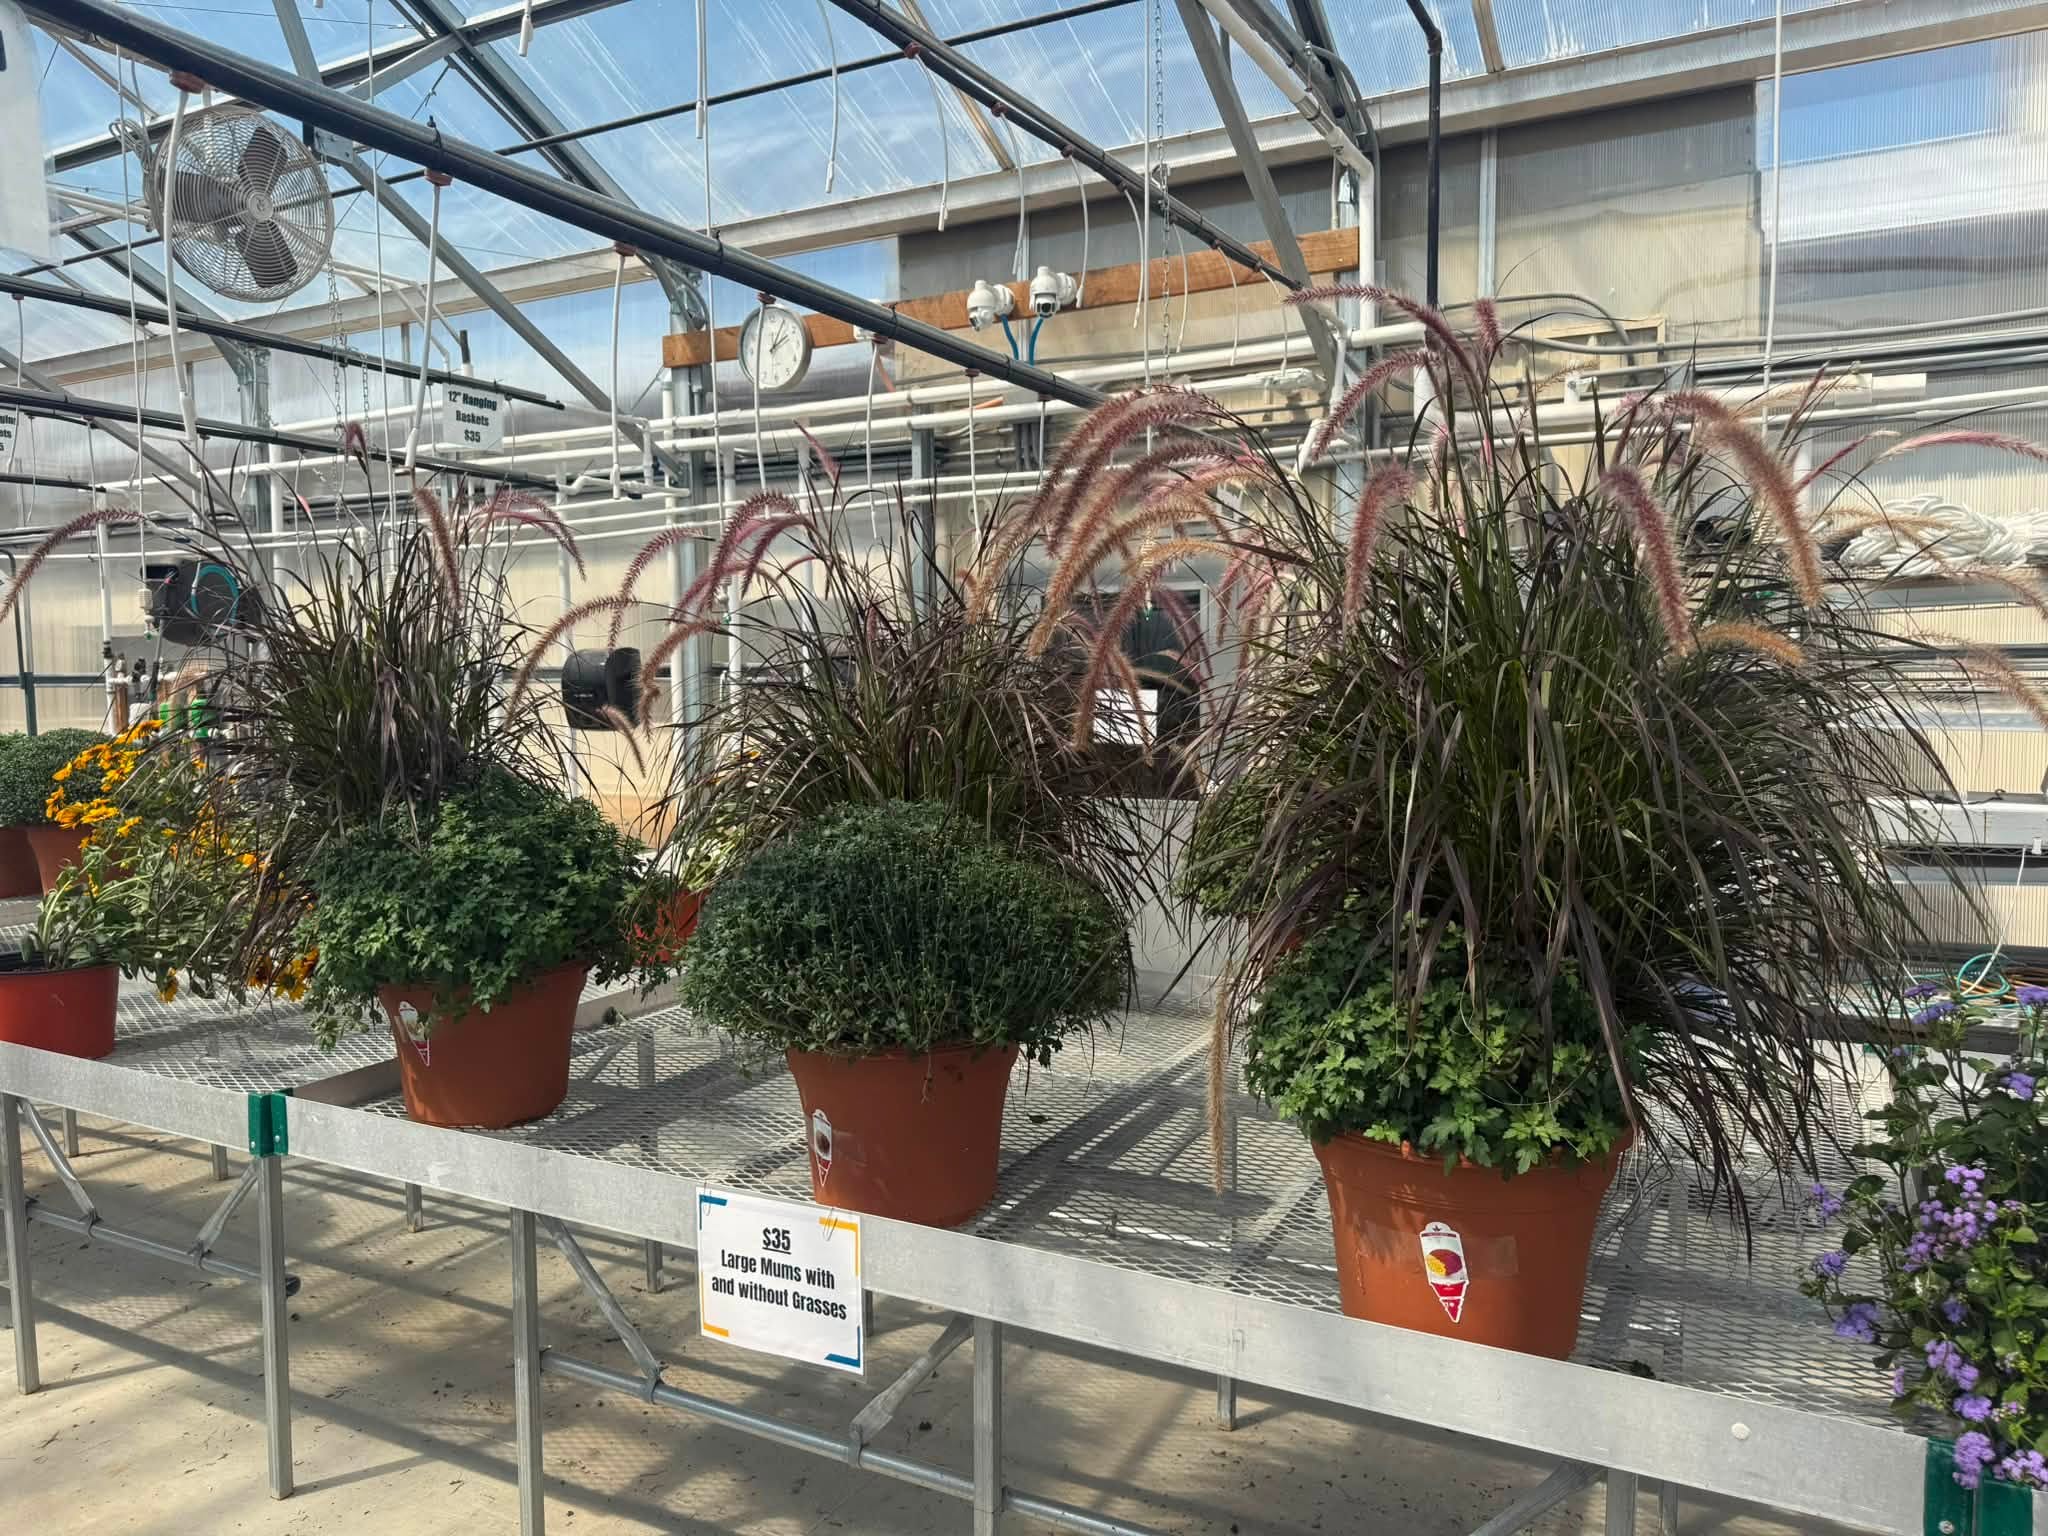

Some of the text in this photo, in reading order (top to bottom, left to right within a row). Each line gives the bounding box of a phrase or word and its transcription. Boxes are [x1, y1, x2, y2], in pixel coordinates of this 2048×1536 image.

[464, 429, 481, 443] $35
[762, 1227, 792, 1252] $35
[721, 1249, 835, 1290] Large Mums with
[712, 1275, 847, 1321] and without Grasses
